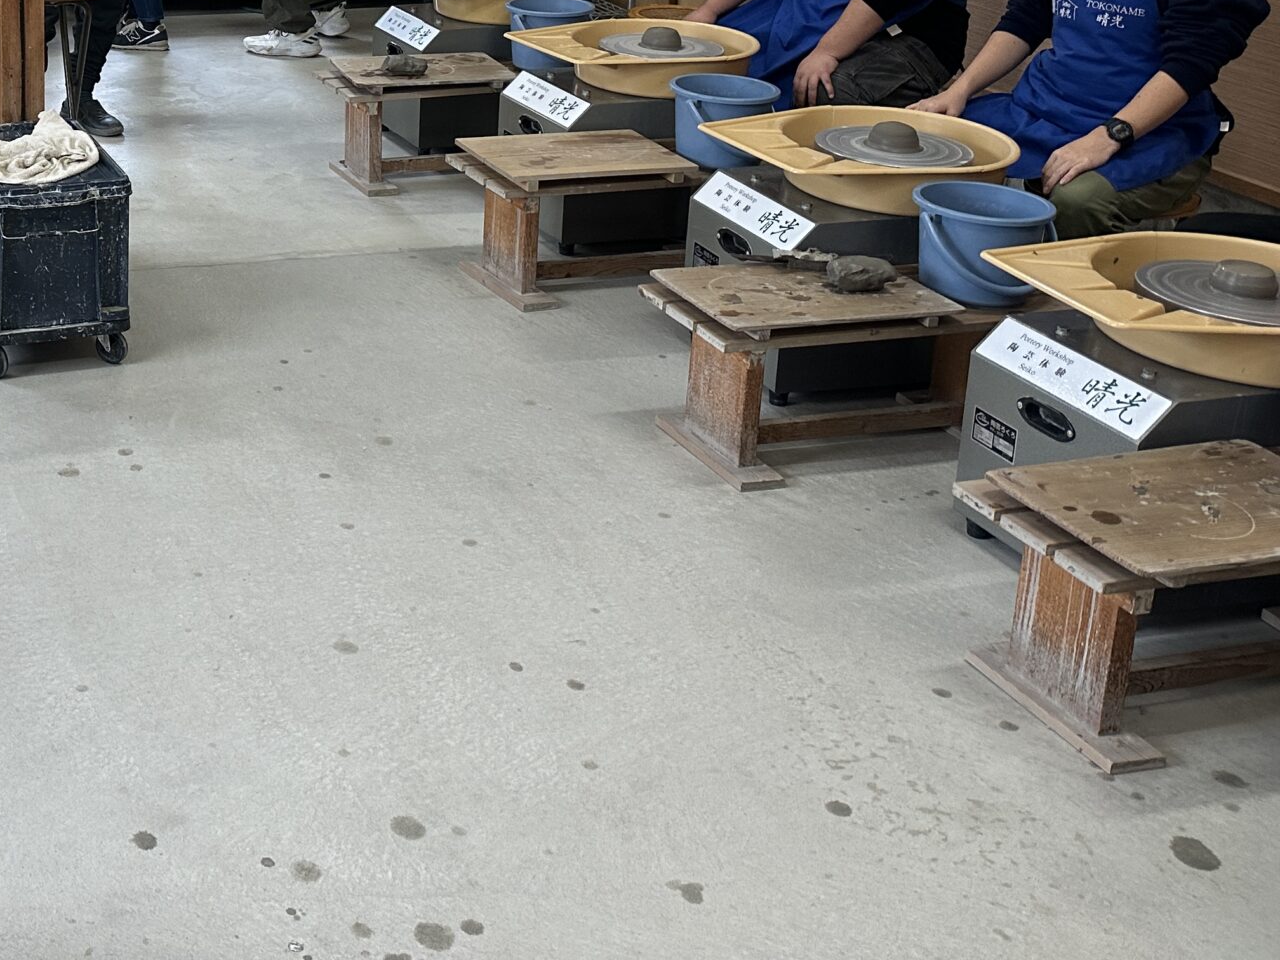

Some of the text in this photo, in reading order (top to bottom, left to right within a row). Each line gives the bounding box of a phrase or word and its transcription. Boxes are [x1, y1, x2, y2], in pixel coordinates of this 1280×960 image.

[1086, 0, 1146, 17] TOKONAME
[1096, 12, 1125, 29] 晴光
[548, 95, 579, 121] 晴光
[757, 210, 800, 244] 晴光
[1006, 342, 1067, 379] 陶芸体験
[1020, 332, 1075, 366] Pottery Workshop
[1020, 362, 1037, 377] Seiko
[1081, 378, 1147, 426] 晴光
